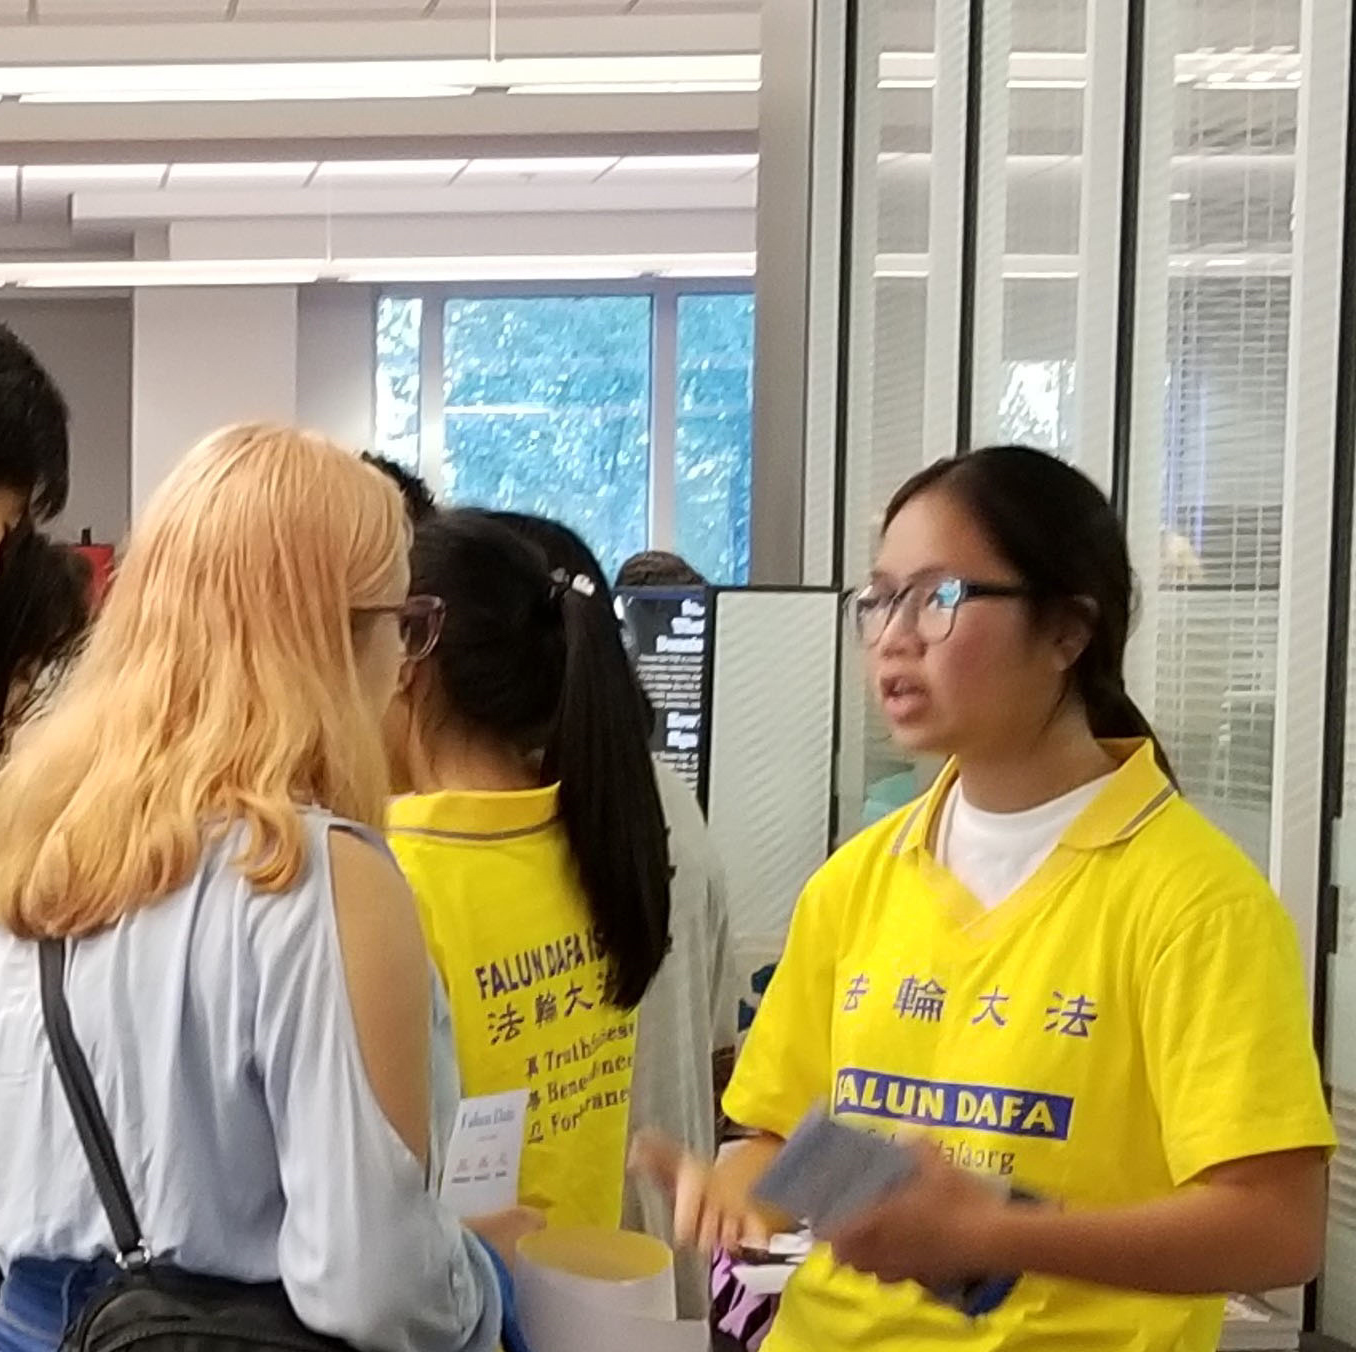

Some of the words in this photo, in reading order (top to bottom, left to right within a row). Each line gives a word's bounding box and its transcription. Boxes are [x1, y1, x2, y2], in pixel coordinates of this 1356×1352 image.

[475, 946, 545, 1001] FALUN
[545, 932, 586, 979] DAFA
[836, 1073, 945, 1121] ALUN
[956, 1091, 1056, 1134] DAFA
